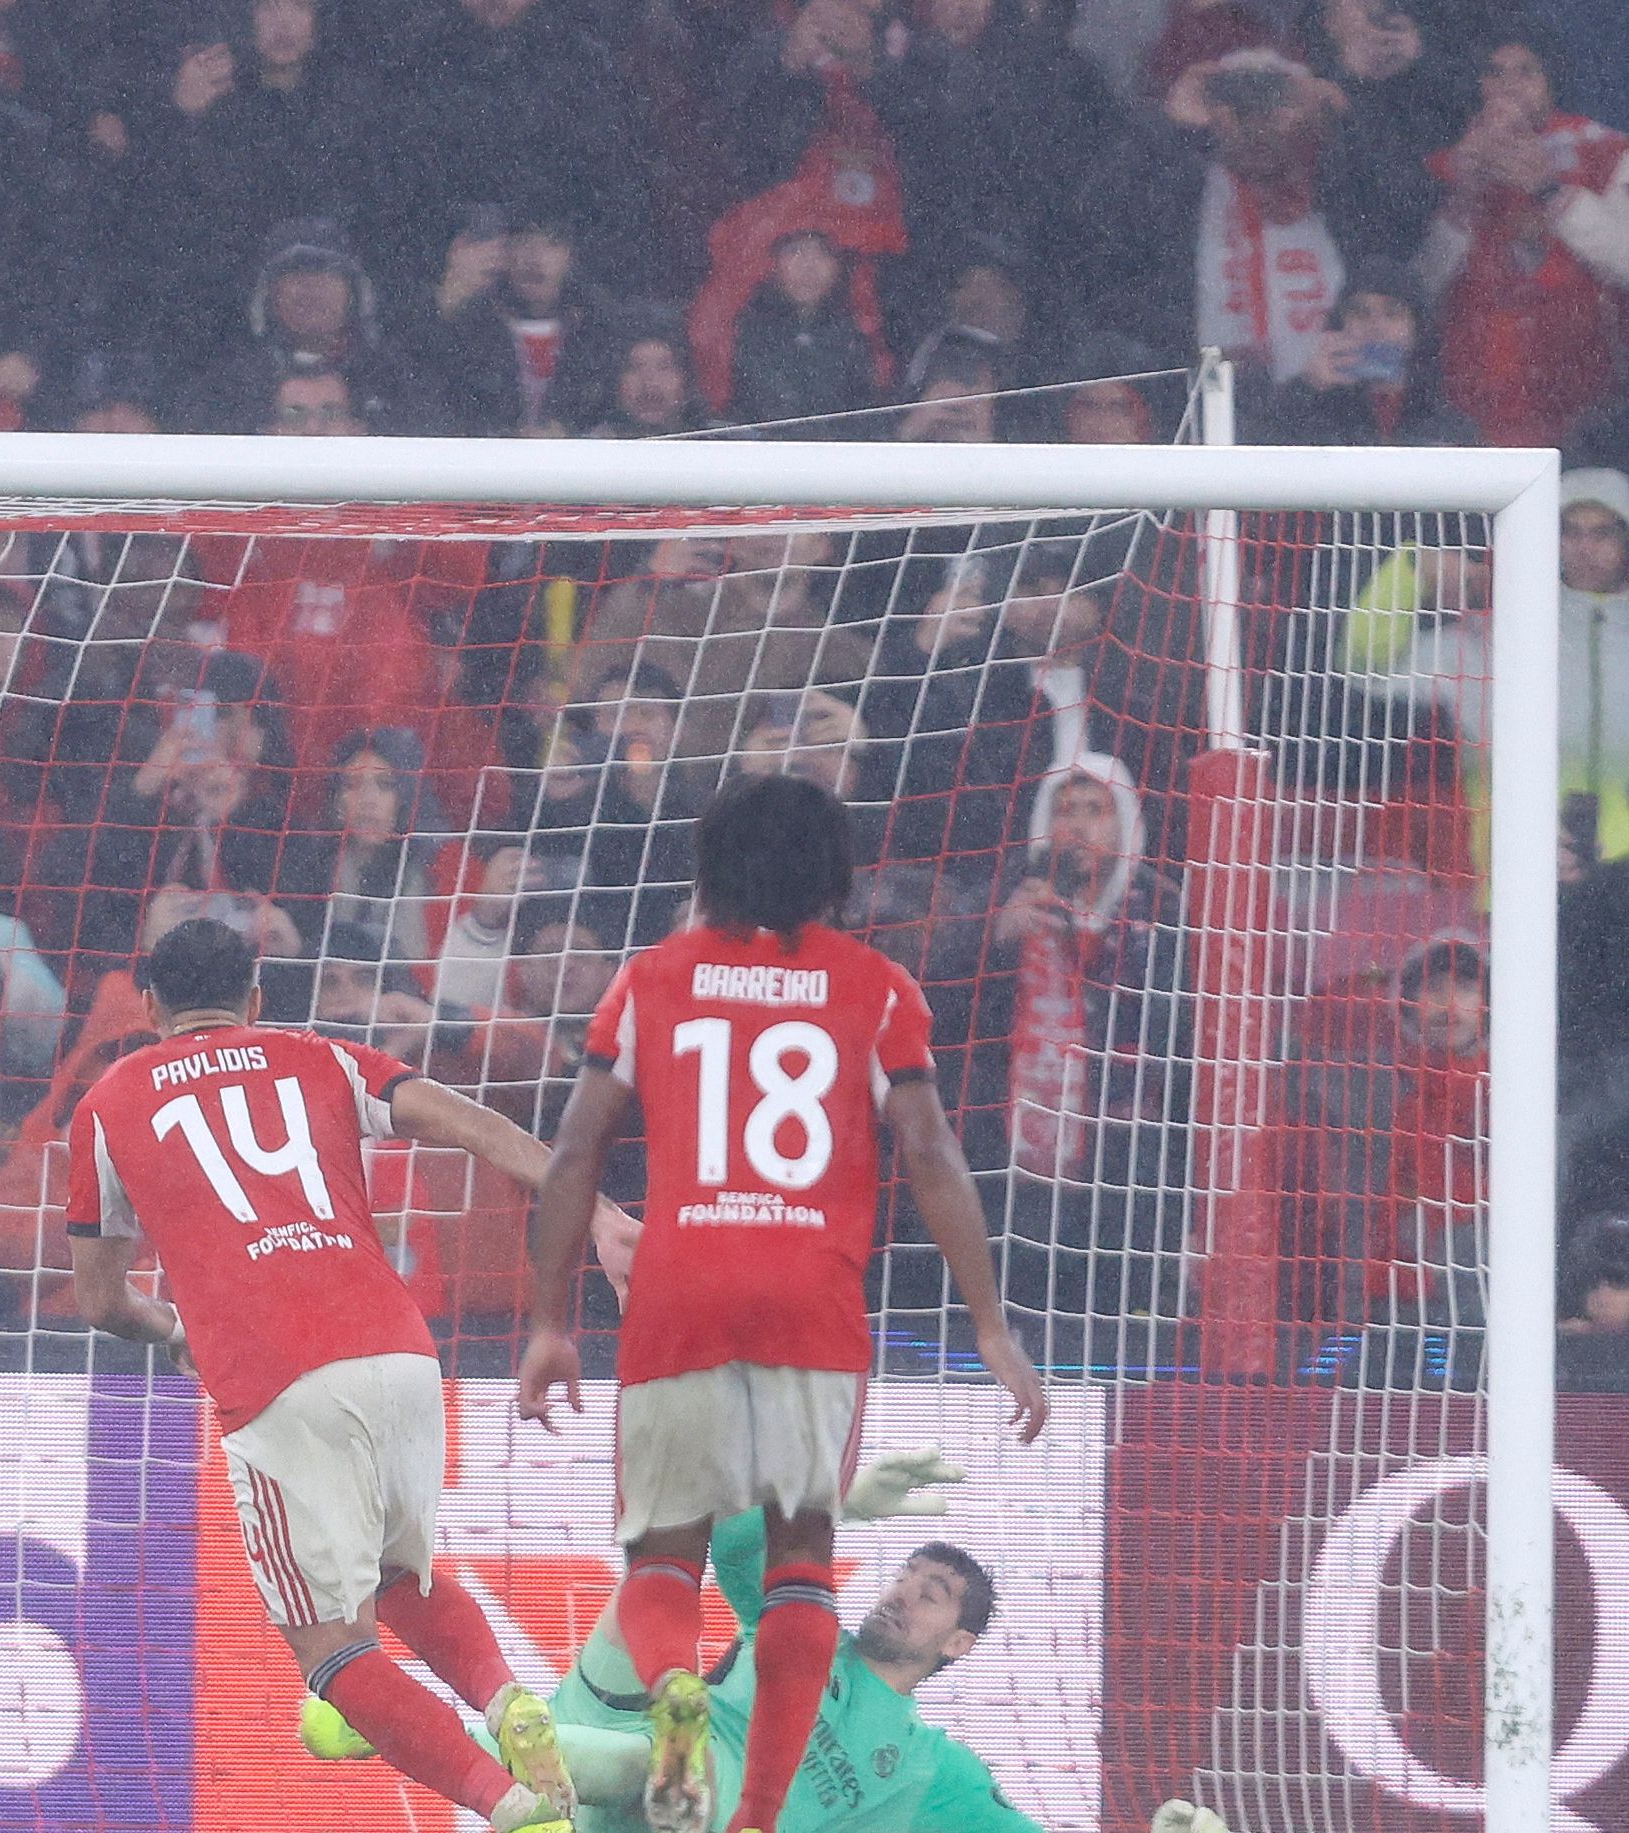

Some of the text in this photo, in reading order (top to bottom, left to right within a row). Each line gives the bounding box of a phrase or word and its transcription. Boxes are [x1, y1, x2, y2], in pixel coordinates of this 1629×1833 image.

[692, 962, 828, 1008] BARREIRO
[151, 1045, 268, 1092] PAVLIDIS
[672, 1016, 840, 1190] 18
[150, 1076, 335, 1223] 14
[677, 1203, 826, 1228] FOUNDATION
[716, 1191, 785, 1206] BENFICA
[811, 1712, 865, 1809] mirates
